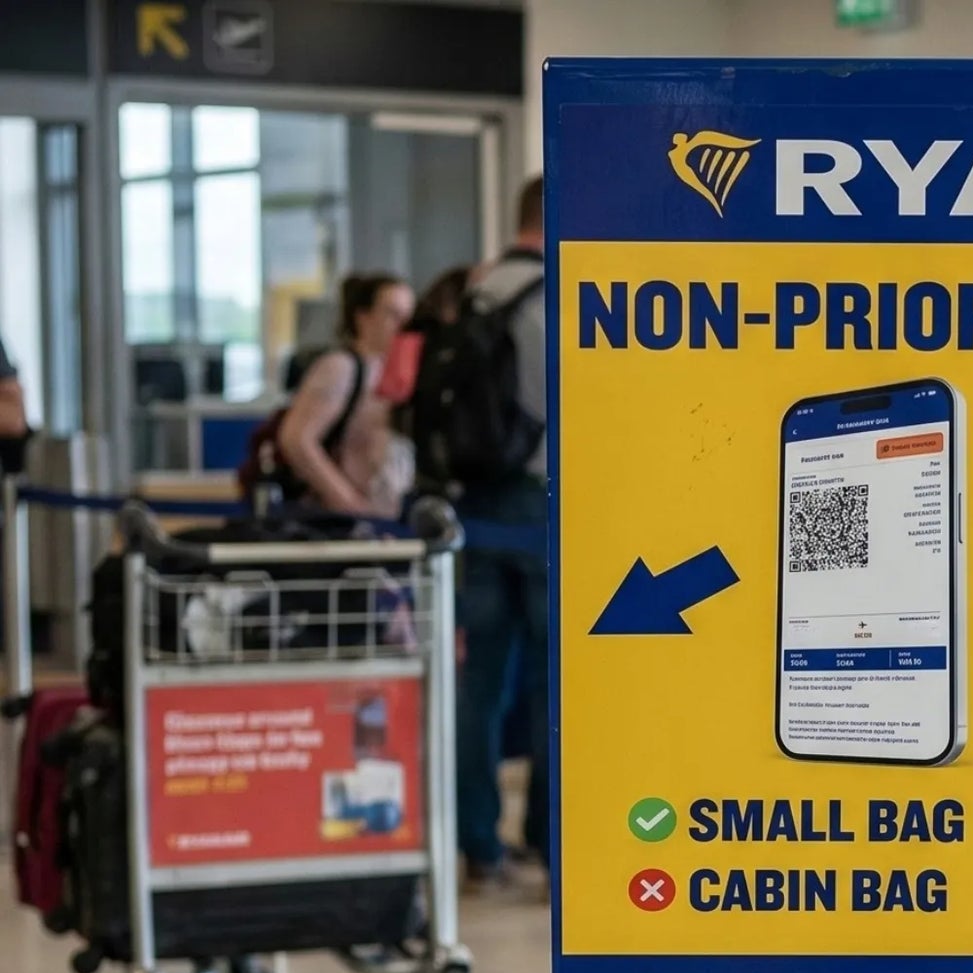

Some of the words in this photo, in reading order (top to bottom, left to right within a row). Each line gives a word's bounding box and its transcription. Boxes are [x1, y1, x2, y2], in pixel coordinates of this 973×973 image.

[688, 798, 855, 843] SMALL
[868, 799, 965, 843] BAG
[689, 868, 837, 913] CABIN
[851, 869, 948, 913] BAG
